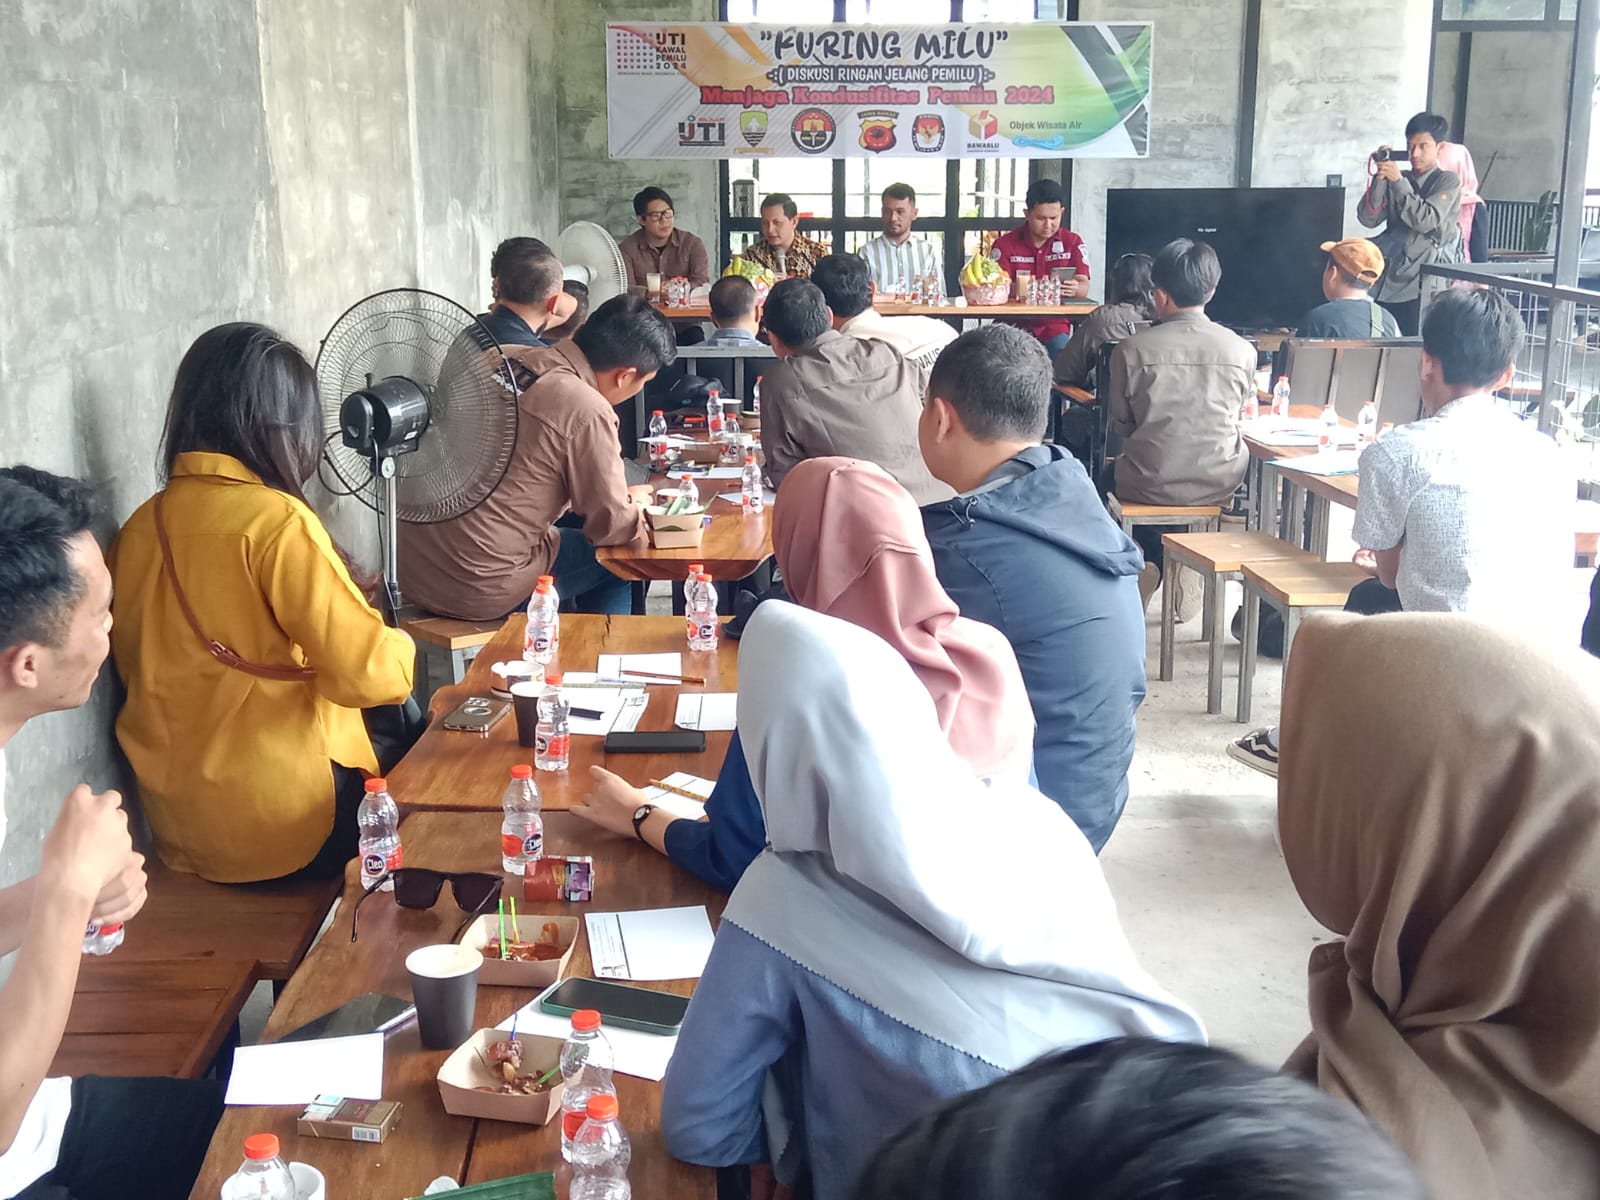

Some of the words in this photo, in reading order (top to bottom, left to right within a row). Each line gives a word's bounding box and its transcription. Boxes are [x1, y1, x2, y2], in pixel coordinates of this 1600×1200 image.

[656, 32, 686, 46] UTI
[656, 46, 686, 54] KAWAL
[656, 54, 687, 62] PEMILU
[656, 62, 687, 70] 2024
[787, 67, 834, 81] DISKUSI
[838, 67, 883, 81] RINGAN
[884, 67, 929, 81] JELANG
[931, 67, 975, 81] PEMILU
[700, 85, 790, 108] Menjaga
[927, 85, 998, 105] Pemilu
[1005, 85, 1056, 105] 2024
[679, 120, 725, 142] UTI
[1009, 120, 1036, 131] Objek
[1037, 120, 1068, 130] Wisata
[1069, 120, 1083, 130] Air
[366, 858, 384, 869] Cleo
